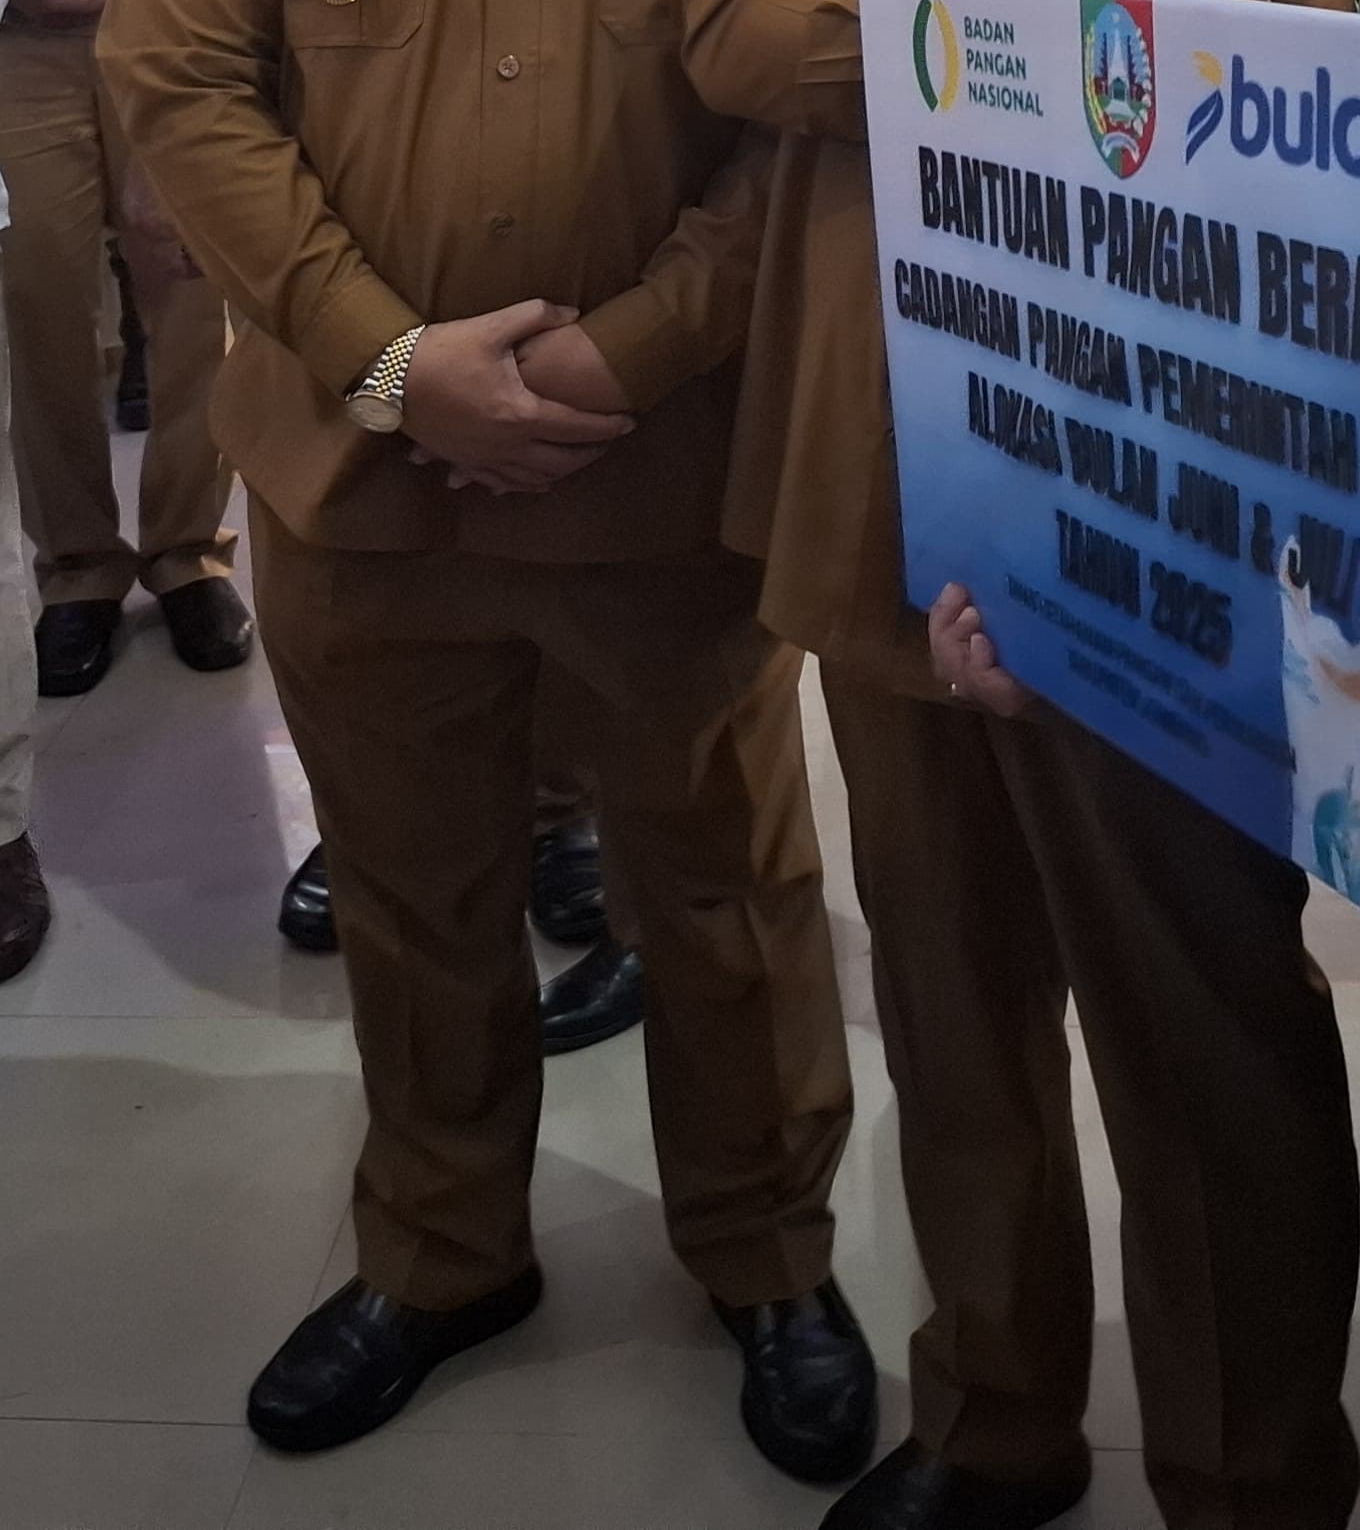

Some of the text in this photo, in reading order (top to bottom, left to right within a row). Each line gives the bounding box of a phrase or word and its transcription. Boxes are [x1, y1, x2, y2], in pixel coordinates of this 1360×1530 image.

[964, 16, 1014, 45] BADAN
[966, 48, 1026, 81] PANGAN
[968, 81, 1043, 117] NASIONAL
[918, 146, 1070, 271] BANTUAN
[1080, 186, 1241, 324] PANGAN
[893, 259, 1021, 361] CADANGAN
[1027, 300, 1132, 408] PANGAN
[968, 371, 1062, 475] ALOKASI
[1063, 416, 1157, 522] BULAN
[1250, 502, 1277, 575] &
[1149, 561, 1233, 667] 2025
